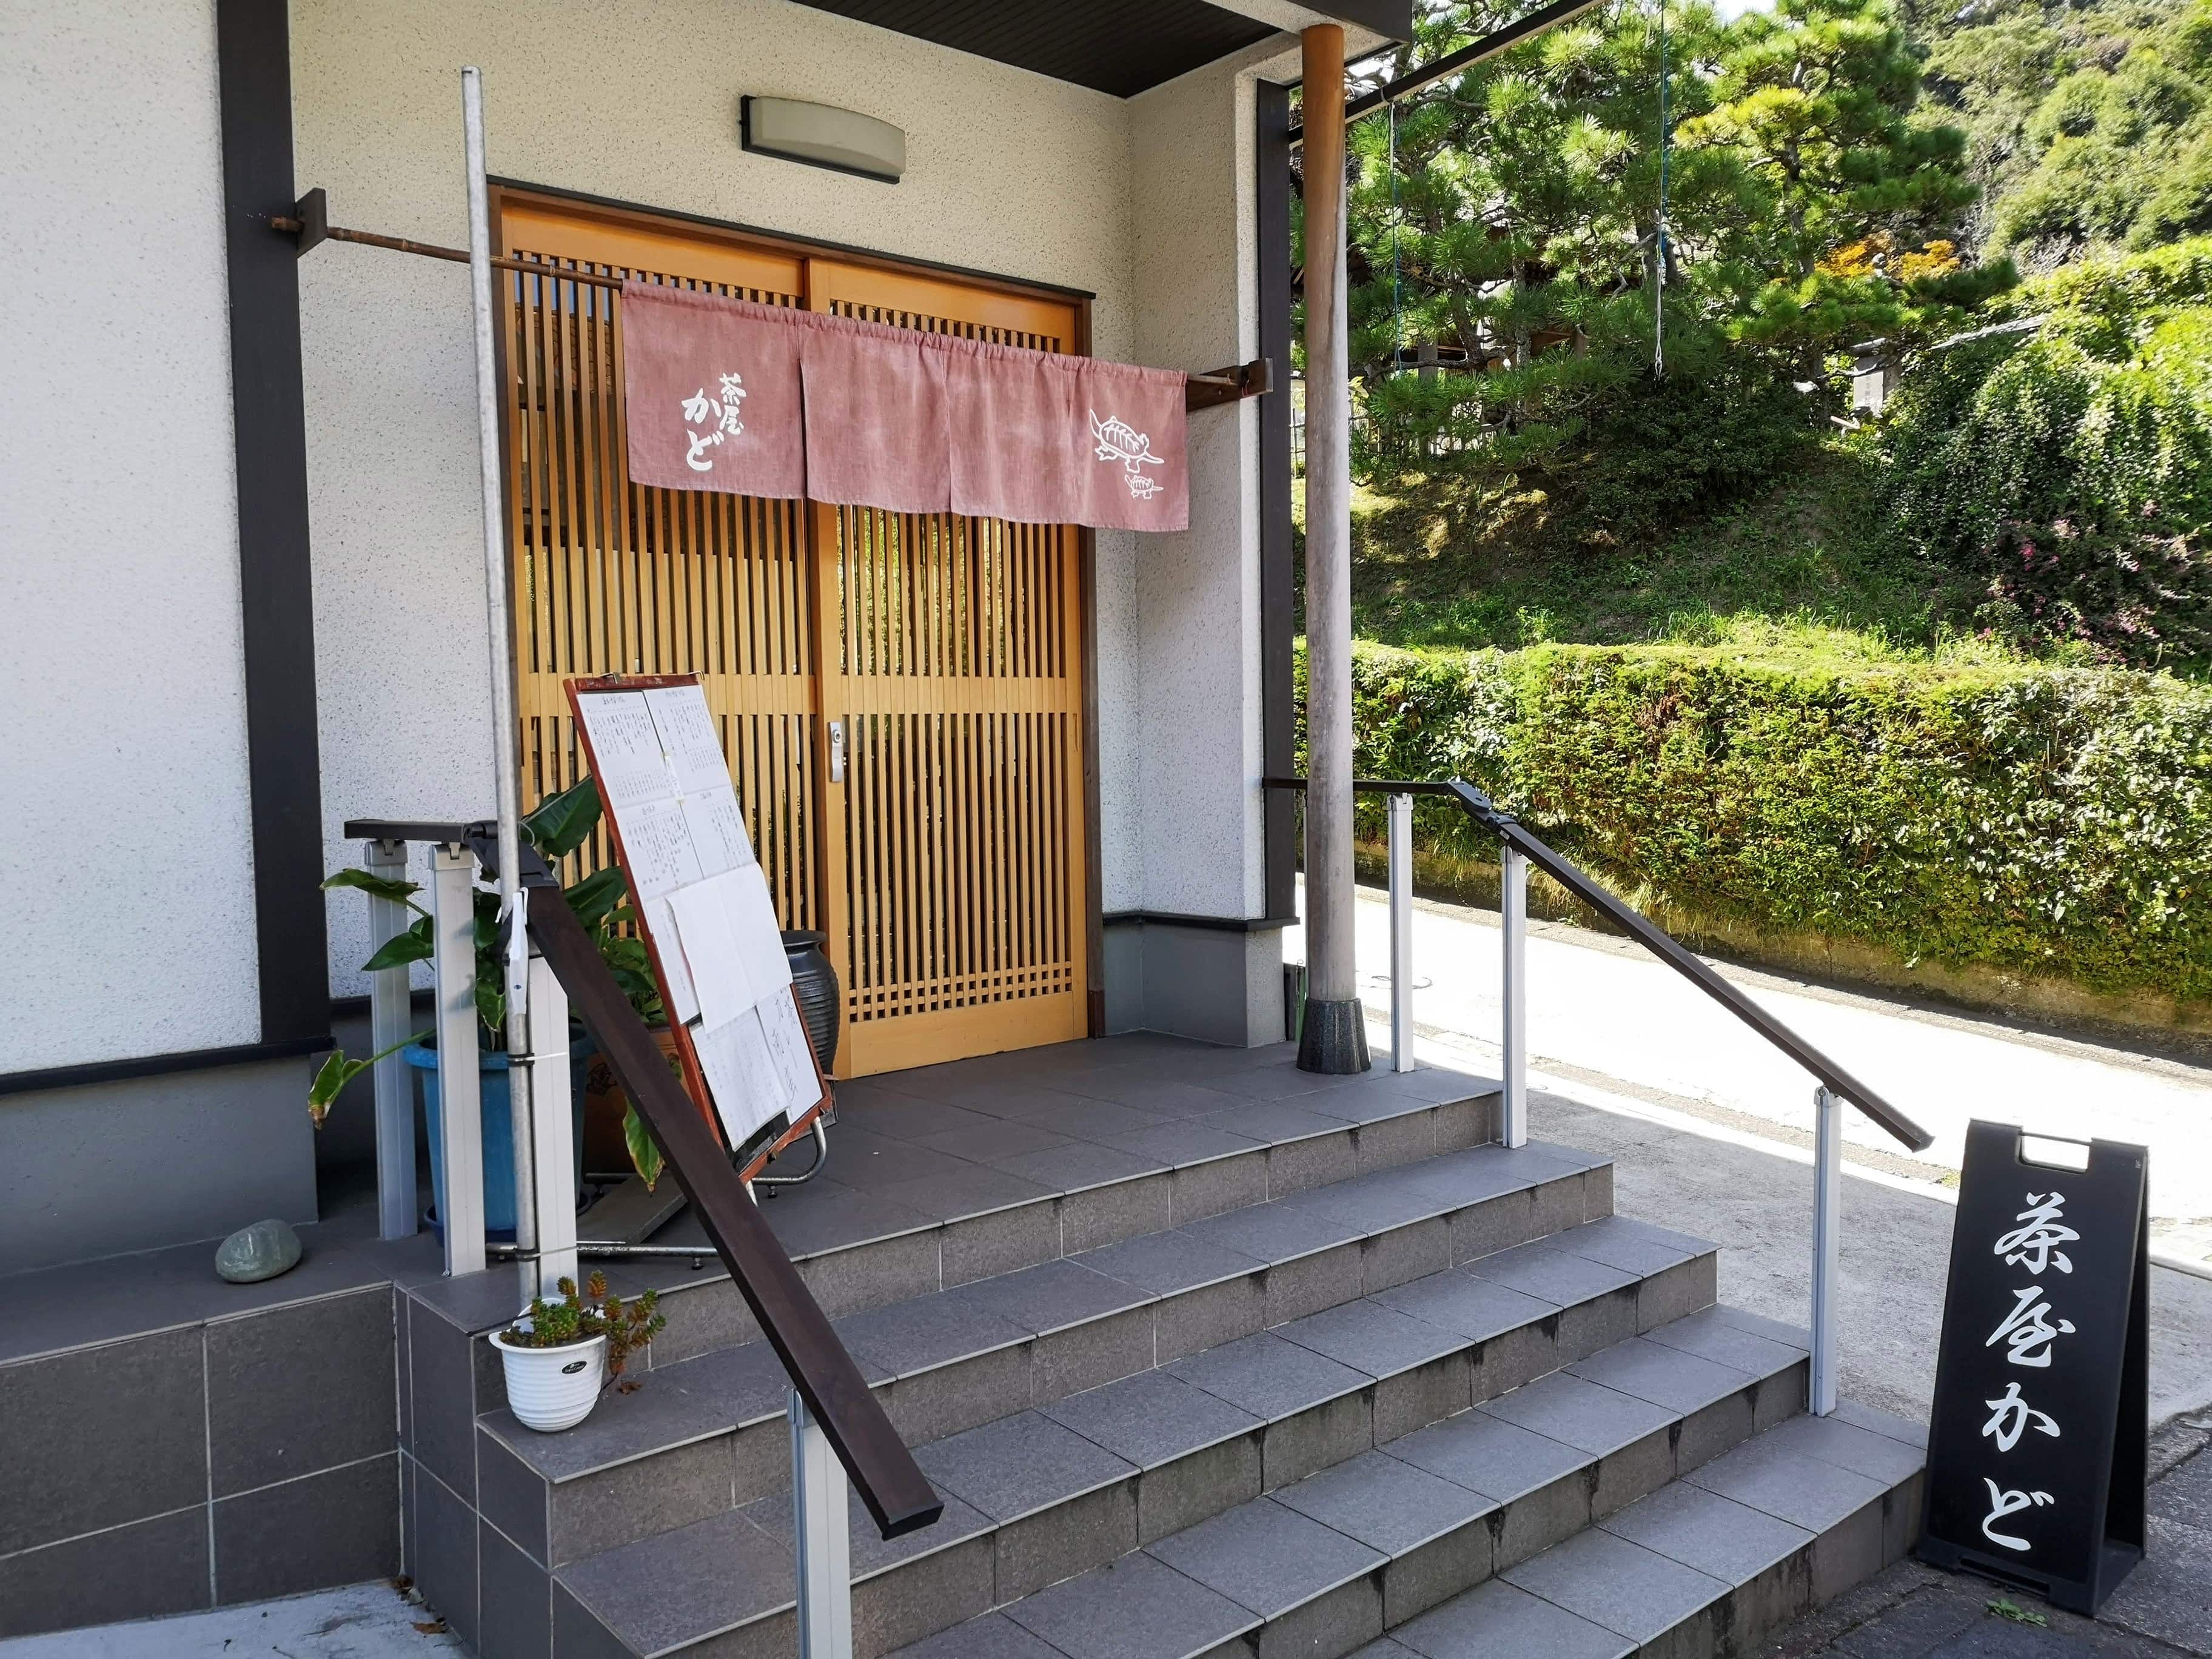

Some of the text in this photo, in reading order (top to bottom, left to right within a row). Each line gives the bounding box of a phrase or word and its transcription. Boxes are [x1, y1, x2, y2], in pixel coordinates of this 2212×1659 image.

[682, 388, 724, 471] かど
[719, 372, 746, 435] 茶屋
[1982, 1191, 2080, 1550] 茶屋かど
